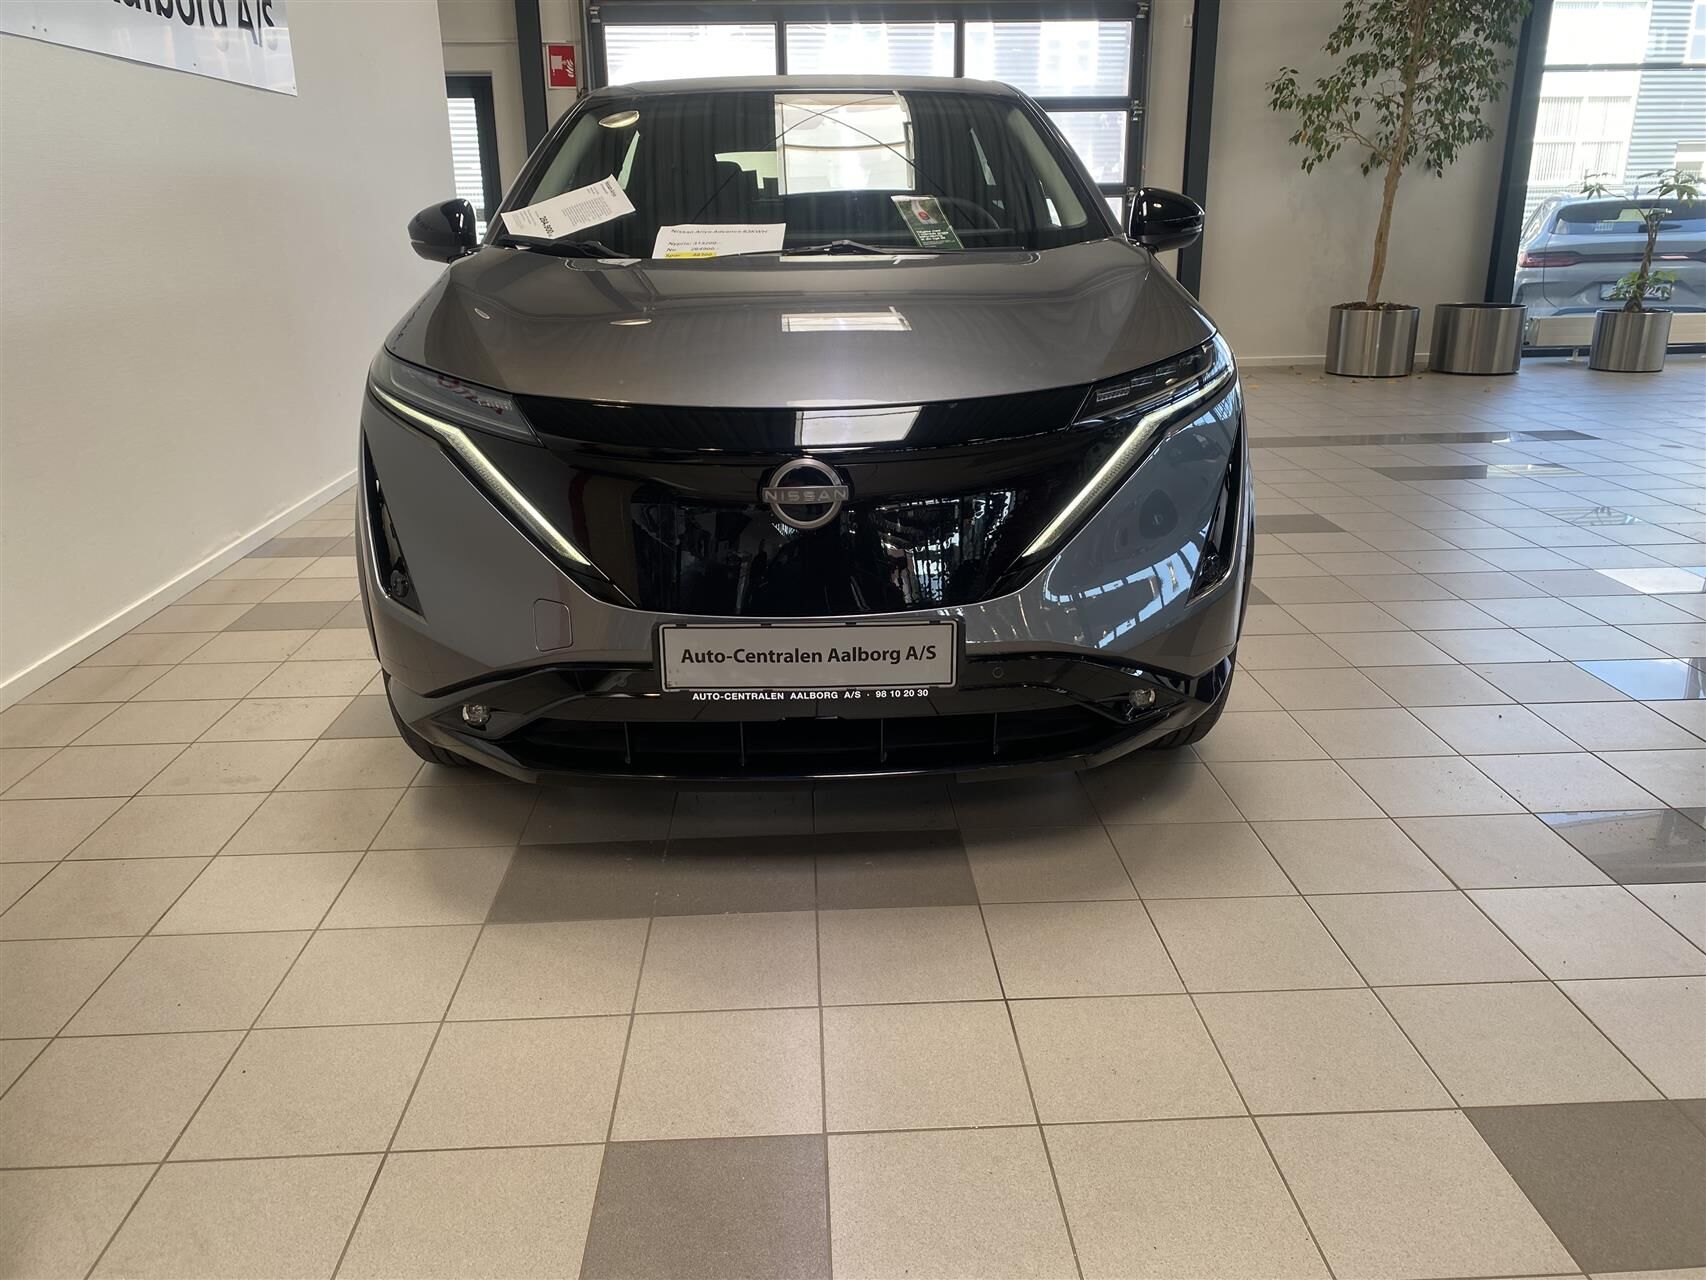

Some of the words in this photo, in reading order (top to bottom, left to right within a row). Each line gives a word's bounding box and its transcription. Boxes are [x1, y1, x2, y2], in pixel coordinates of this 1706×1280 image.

[764, 489, 846, 502] NISSAN
[681, 648, 823, 664] Auto-Centralen
[827, 647, 901, 665] Aalborg
[905, 645, 937, 661] A/S
[692, 692, 785, 701] AUTO-CENTRALEN
[790, 691, 838, 700] AALBORG
[844, 690, 862, 699] A/S
[875, 689, 887, 698] 98
[890, 689, 901, 698] 10
[903, 689, 915, 698] 20
[917, 689, 929, 697] 30
